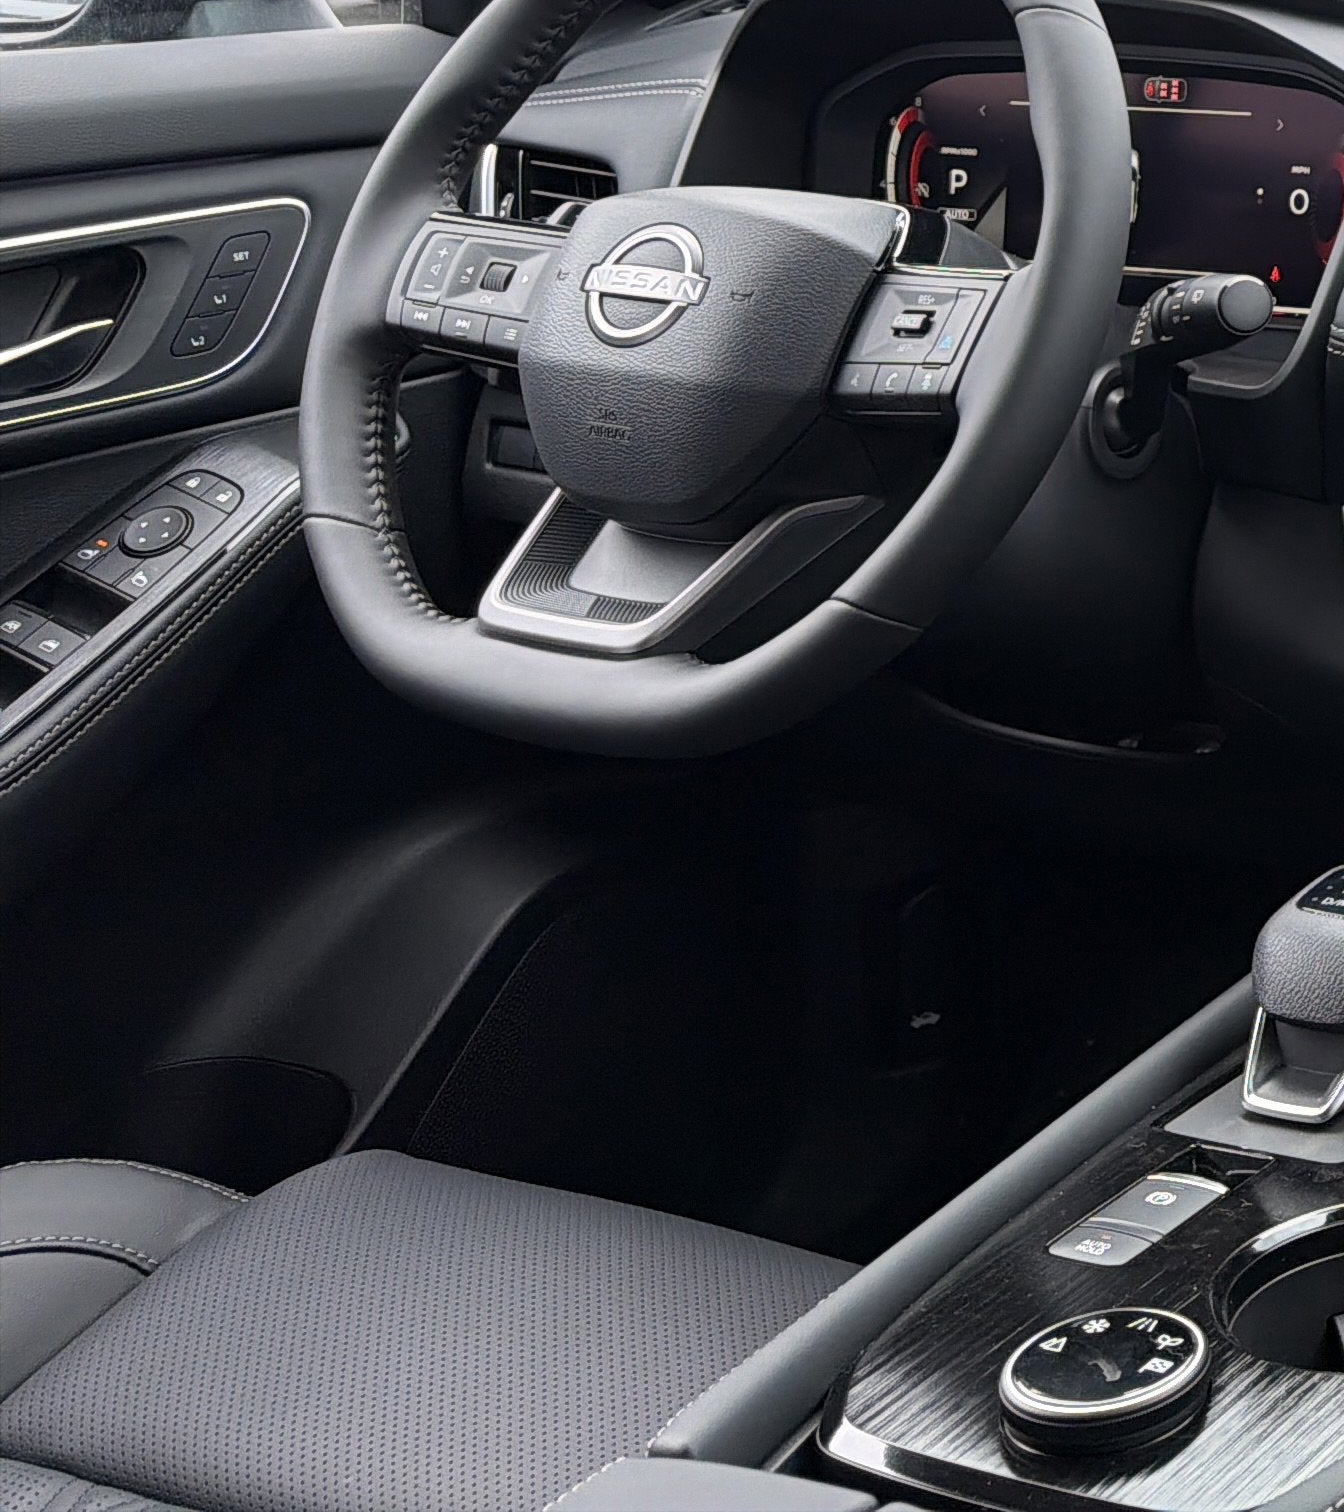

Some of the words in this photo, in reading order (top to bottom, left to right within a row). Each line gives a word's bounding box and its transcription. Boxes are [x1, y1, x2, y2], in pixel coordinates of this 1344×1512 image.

[1291, 165, 1311, 175] MPH
[949, 168, 968, 195] P
[1289, 188, 1310, 215] 0
[945, 209, 970, 219] AUTO
[232, 250, 250, 262] SET
[584, 267, 704, 301] NISSAN
[1075, 1244, 1105, 1255] HOLD
[1081, 1239, 1112, 1250] AUTO
